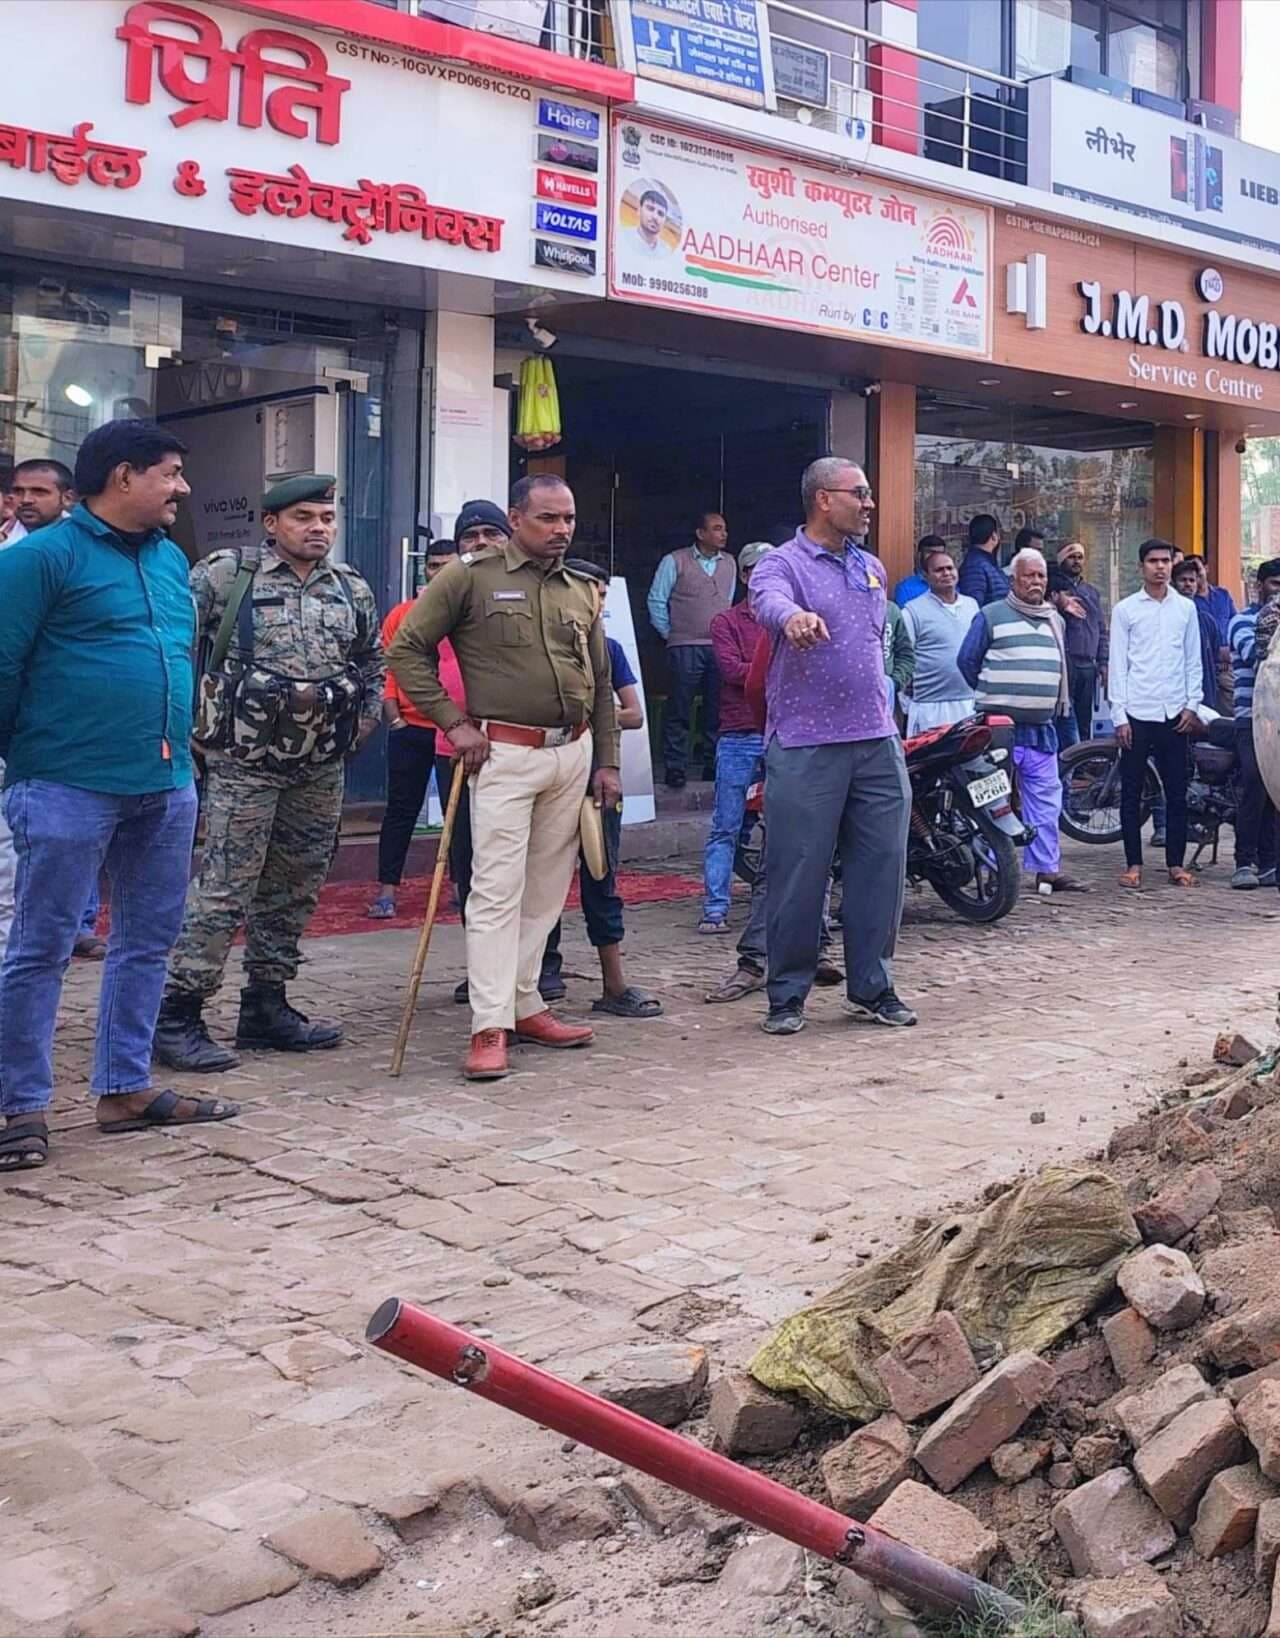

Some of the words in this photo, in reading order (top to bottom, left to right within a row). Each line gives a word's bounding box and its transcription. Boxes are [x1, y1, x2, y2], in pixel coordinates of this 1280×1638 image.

[116, 1, 351, 146] प्रिति
[547, 106, 592, 131] Haier
[1084, 127, 1137, 163] लीभेर
[174, 160, 207, 197] &
[556, 181, 591, 197] HAVELLS
[746, 164, 796, 200] खुशी
[878, 193, 917, 226] जोन
[542, 210, 592, 233] VOLTAS
[742, 203, 828, 239] Authorised
[544, 246, 590, 266] Whirlpool
[683, 227, 804, 275] AADHAAR
[812, 254, 880, 289] Center
[925, 245, 973, 263] AADHAAR
[622, 272, 647, 289] Mob:
[819, 304, 840, 319] Run
[843, 307, 856, 323] by
[1128, 352, 1197, 389] Service
[1205, 366, 1263, 400] Centre
